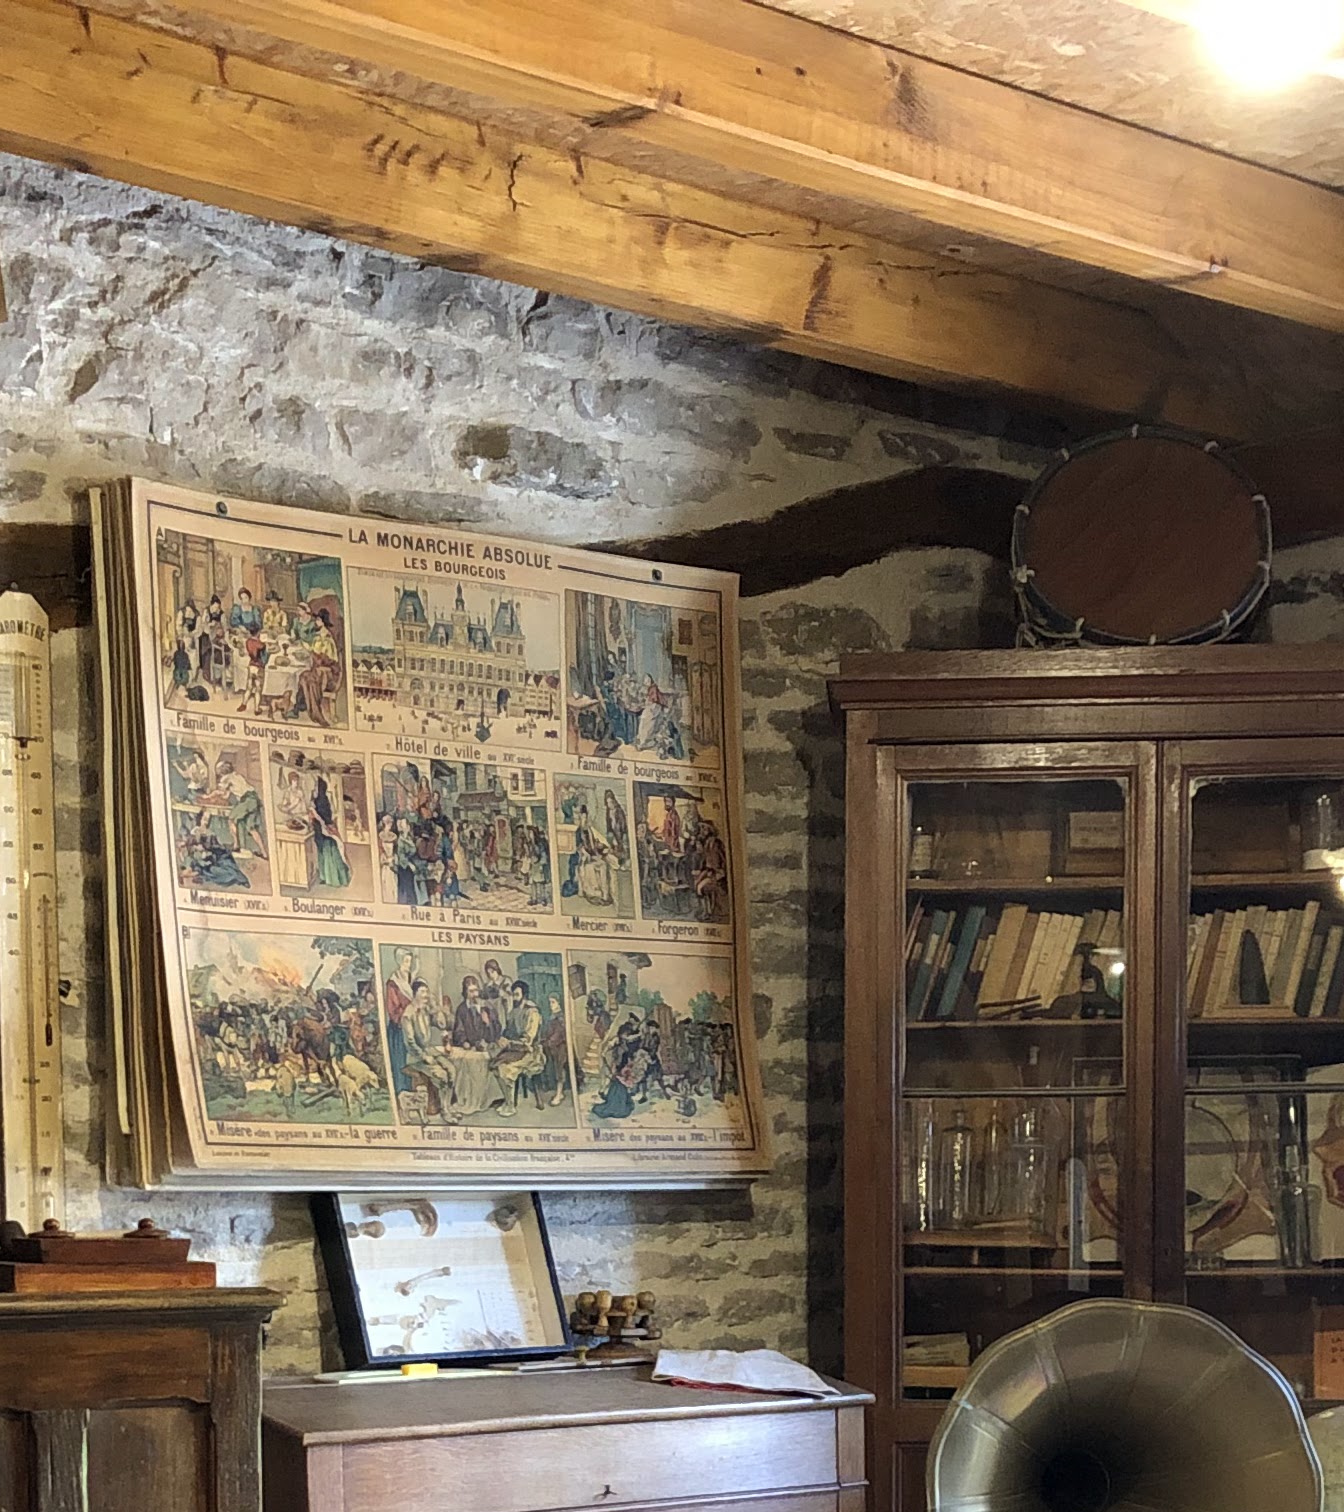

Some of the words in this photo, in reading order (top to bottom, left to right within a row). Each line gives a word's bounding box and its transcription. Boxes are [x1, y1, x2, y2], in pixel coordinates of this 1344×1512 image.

[156, 526, 164, 539] A
[348, 527, 368, 545] LA
[377, 531, 475, 559] MONARCHIE
[482, 545, 553, 570] ABSOLUE
[404, 557, 428, 570] LES
[435, 560, 506, 581] BOURGEOIS
[176, 712, 216, 733] Famille
[223, 720, 236, 735] de
[243, 721, 300, 743] bourgeois
[395, 736, 428, 754] Hôtel
[434, 742, 449, 757] de
[455, 745, 481, 760] ville
[578, 755, 611, 773] Famille
[618, 761, 629, 775] de
[634, 762, 680, 782] bourgeois
[292, 898, 346, 919] Boulanger
[411, 906, 431, 921] Rue
[453, 909, 482, 925] Paris
[572, 916, 608, 932] Mercier
[657, 920, 699, 940] Forgeron
[432, 932, 452, 943] LES
[458, 933, 510, 947] PAYSANS
[216, 1121, 253, 1138] Misère
[364, 1128, 398, 1144] guerre
[421, 1125, 457, 1142] Famille
[463, 1127, 475, 1142] de
[480, 1131, 520, 1146] paysans
